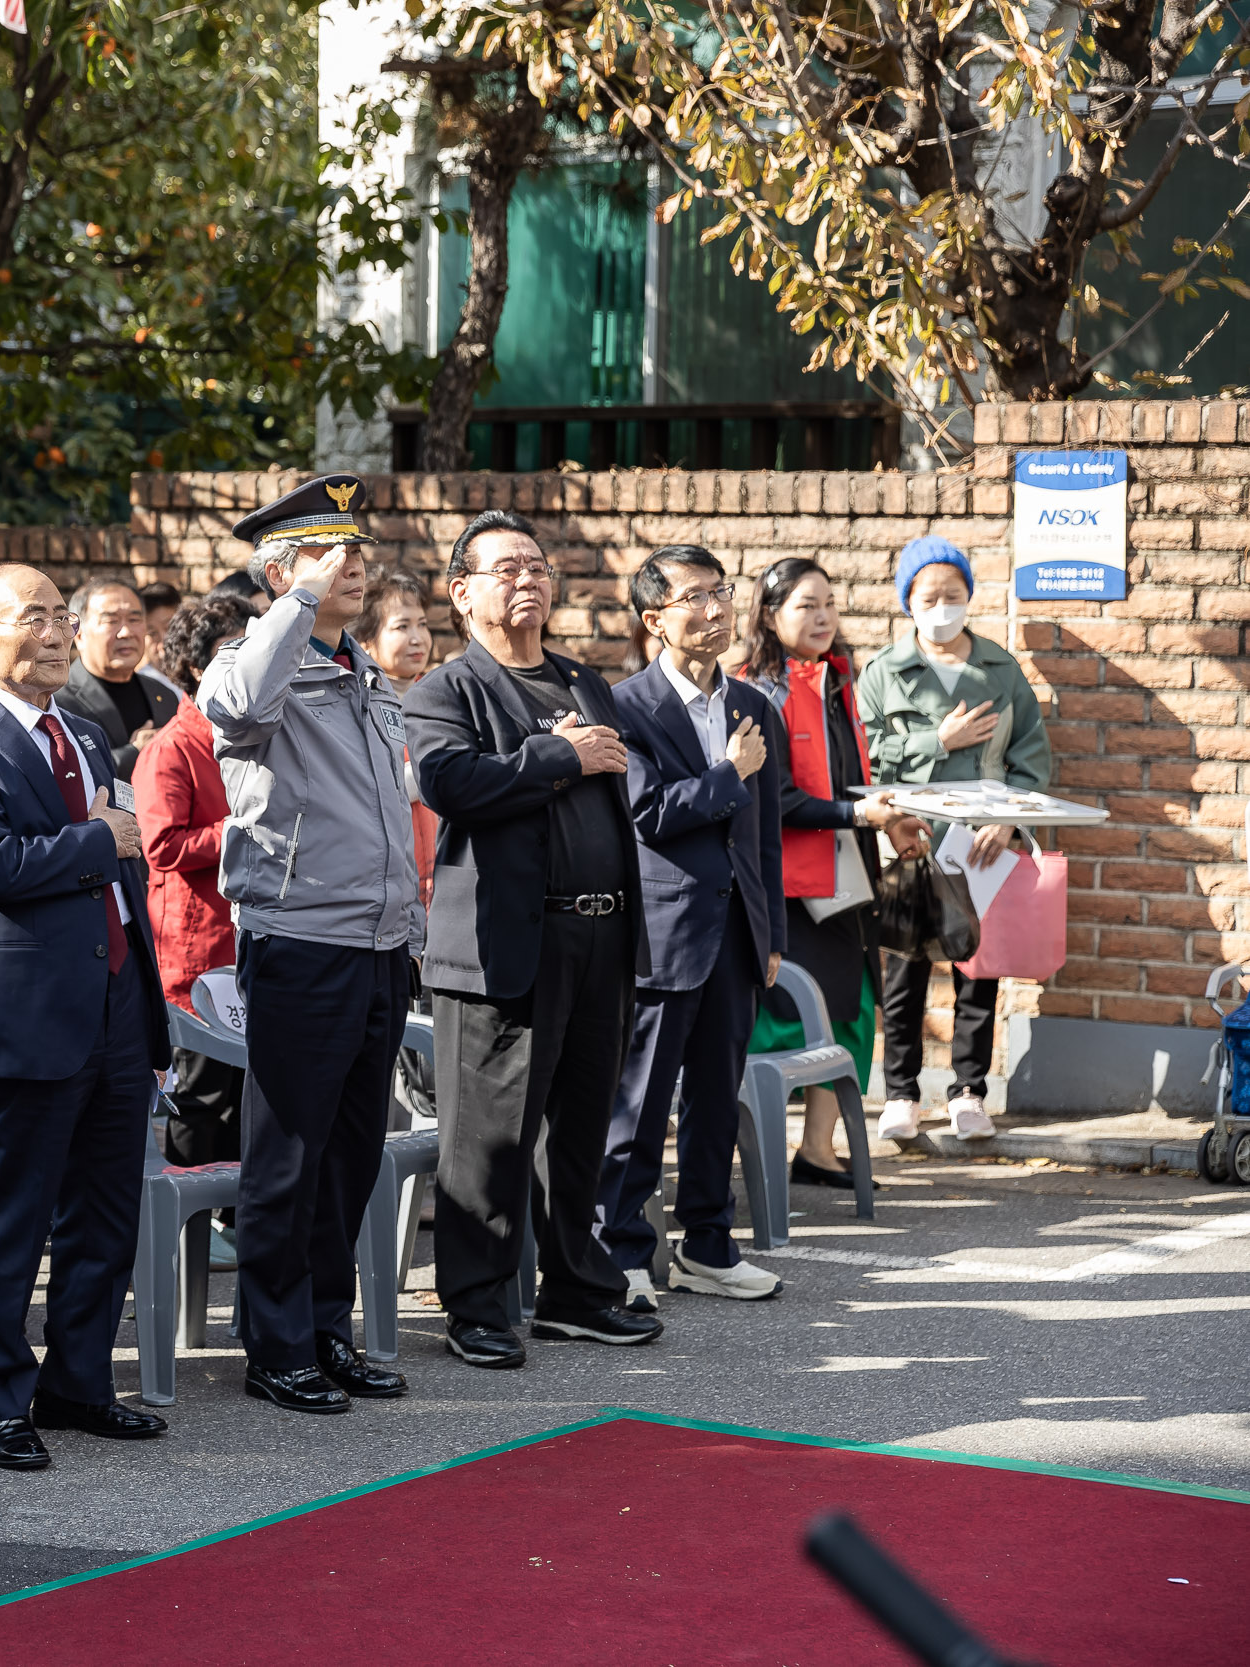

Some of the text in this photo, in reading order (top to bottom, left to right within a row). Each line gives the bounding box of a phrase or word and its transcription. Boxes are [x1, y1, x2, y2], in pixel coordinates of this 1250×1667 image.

[1028, 463, 1115, 476] Security & Safety
[1038, 509, 1100, 526] NSOK
